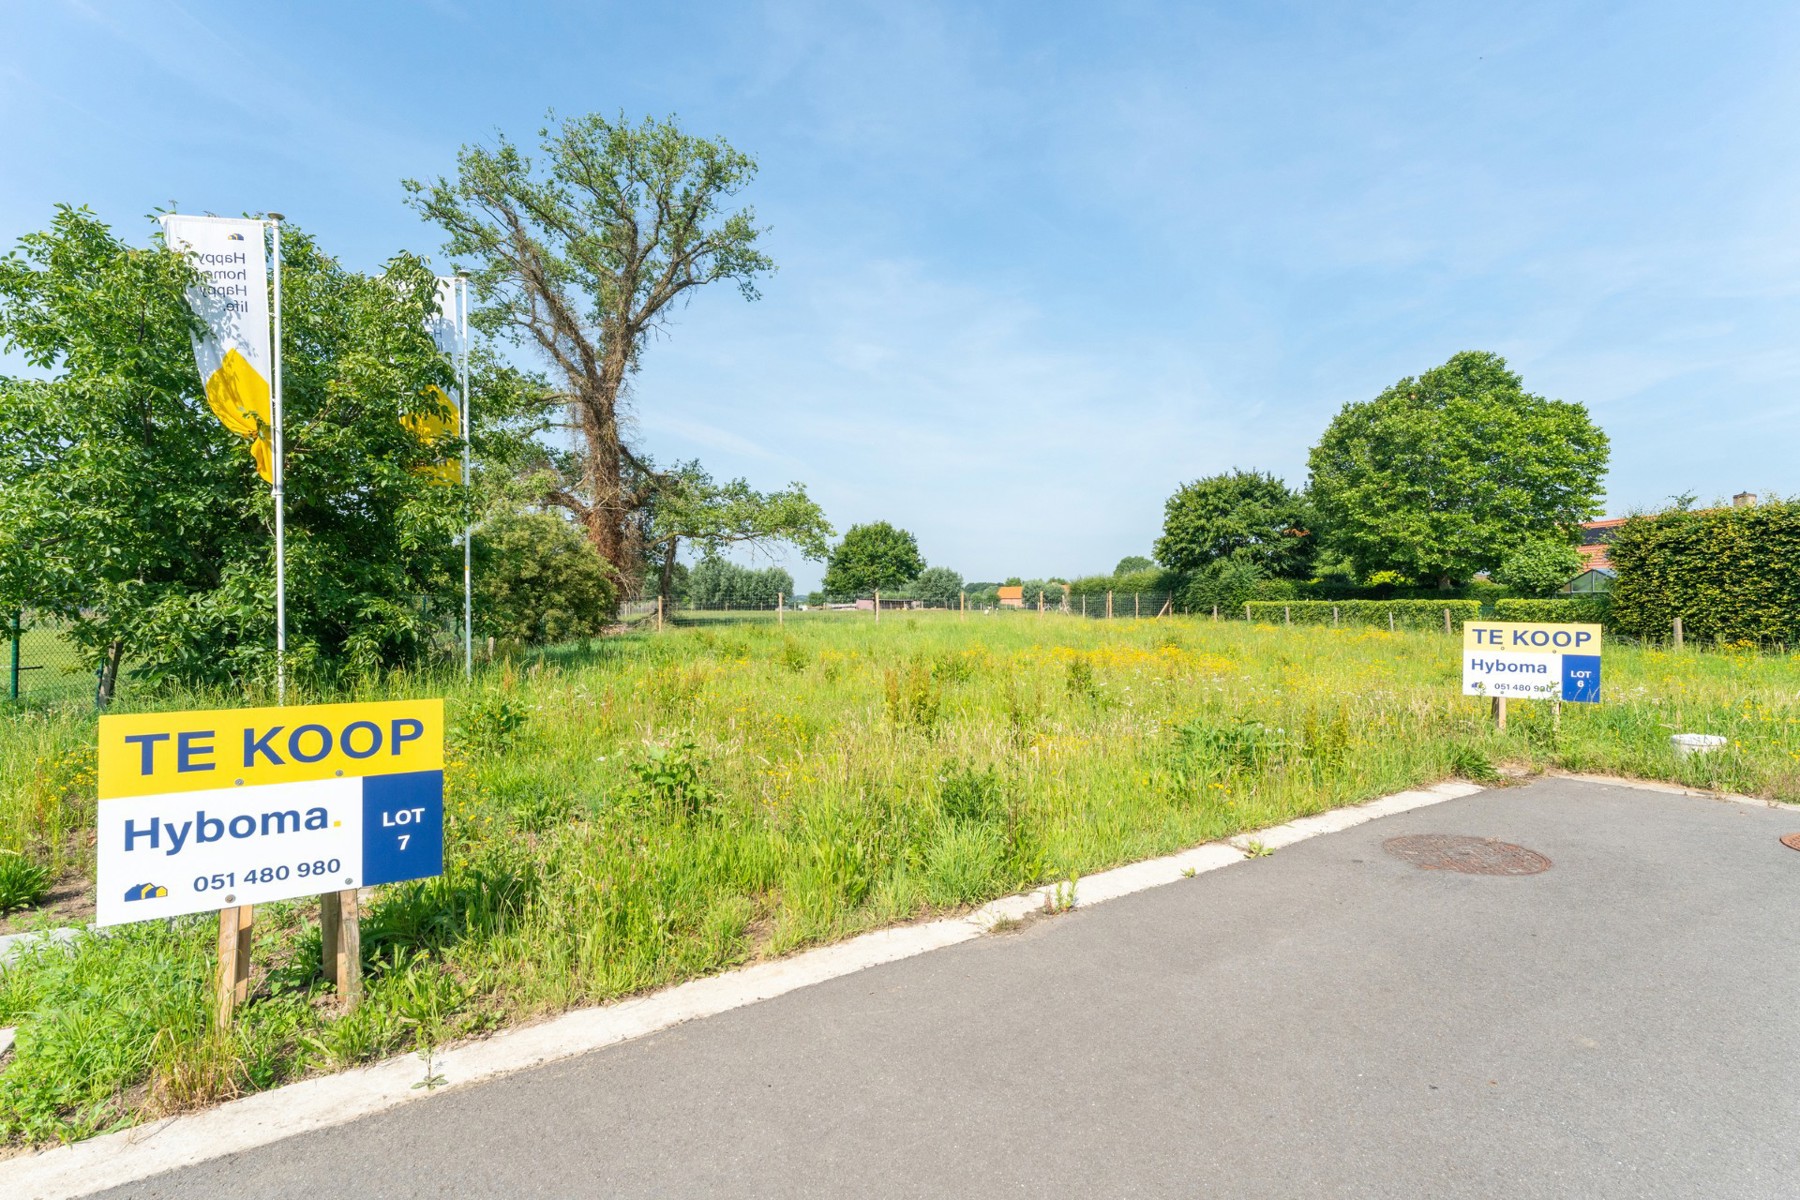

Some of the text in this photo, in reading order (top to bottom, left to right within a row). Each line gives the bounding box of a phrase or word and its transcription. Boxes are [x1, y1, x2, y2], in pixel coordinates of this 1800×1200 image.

[1472, 629, 1592, 647] TE KOOP
[1471, 658, 1547, 674] Hyboma
[1570, 670, 1592, 678] LOT
[1494, 682, 1510, 691] 051
[1513, 683, 1531, 692] 480
[1577, 680, 1584, 688] 6
[124, 718, 424, 776] TE KOOP
[382, 807, 425, 827] LOT
[124, 806, 342, 856] Hyboma.
[397, 834, 410, 851] 7
[193, 858, 341, 892] 051 480 980
